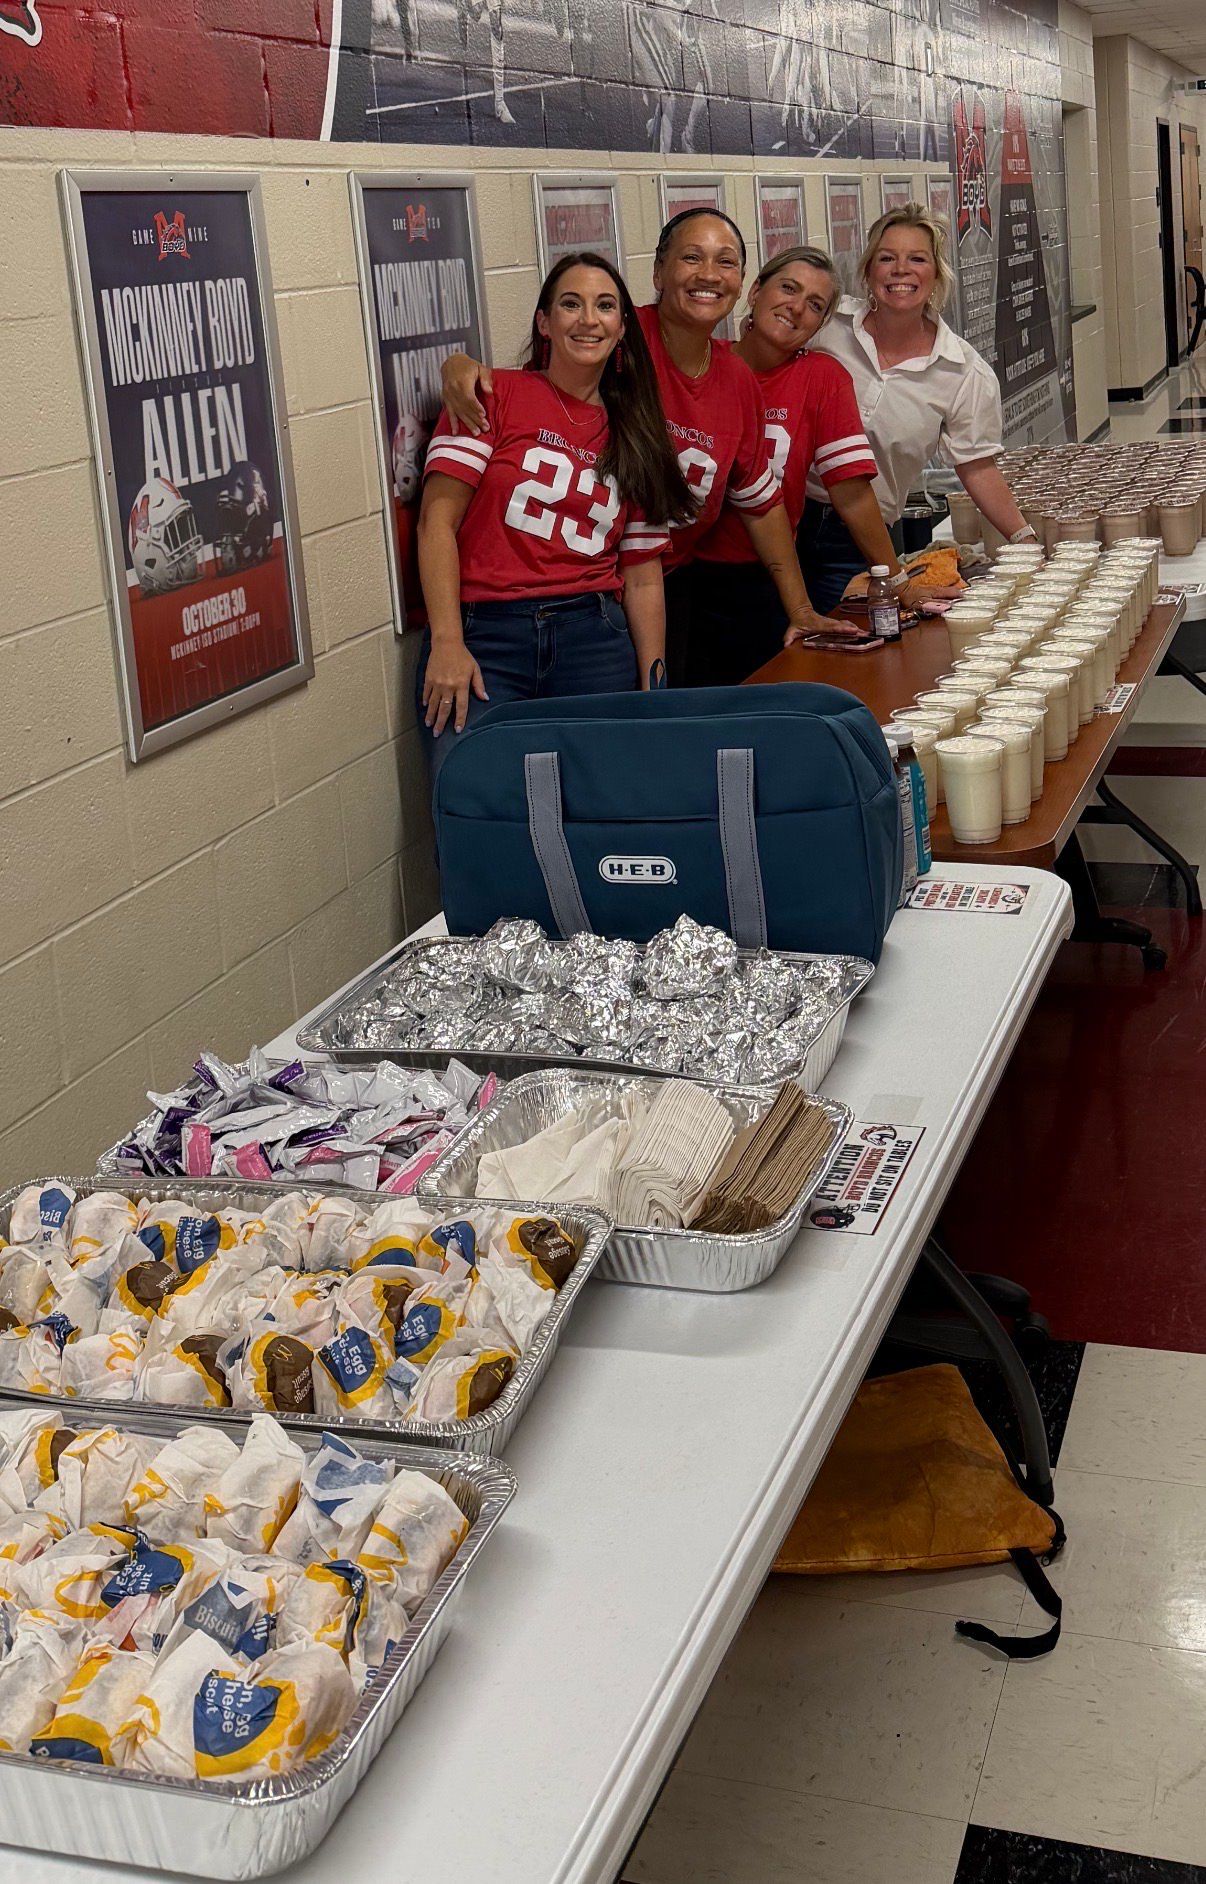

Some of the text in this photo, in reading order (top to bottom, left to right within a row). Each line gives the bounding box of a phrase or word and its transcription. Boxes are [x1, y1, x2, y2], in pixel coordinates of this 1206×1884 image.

[132, 226, 208, 245] GAME NINE
[374, 258, 471, 341] MCKINNEY BOYD
[101, 277, 255, 386] MCKINNEY BOYD
[142, 383, 248, 488] ALLEN
[665, 420, 714, 449] ONCOS
[504, 447, 621, 556] 23
[182, 587, 247, 636] OCTOBER 30
[171, 636, 201, 660] MCKINNEY
[886, 1140, 913, 1163] TABLES
[815, 1143, 865, 1201] ATTENTION
[845, 1147, 886, 1201] BOYD BRONCOS
[875, 1175, 895, 1186] SIT
[881, 1164, 901, 1175] ON
[868, 1187, 889, 1201] NOT
[348, 1345, 368, 1376] Egg
